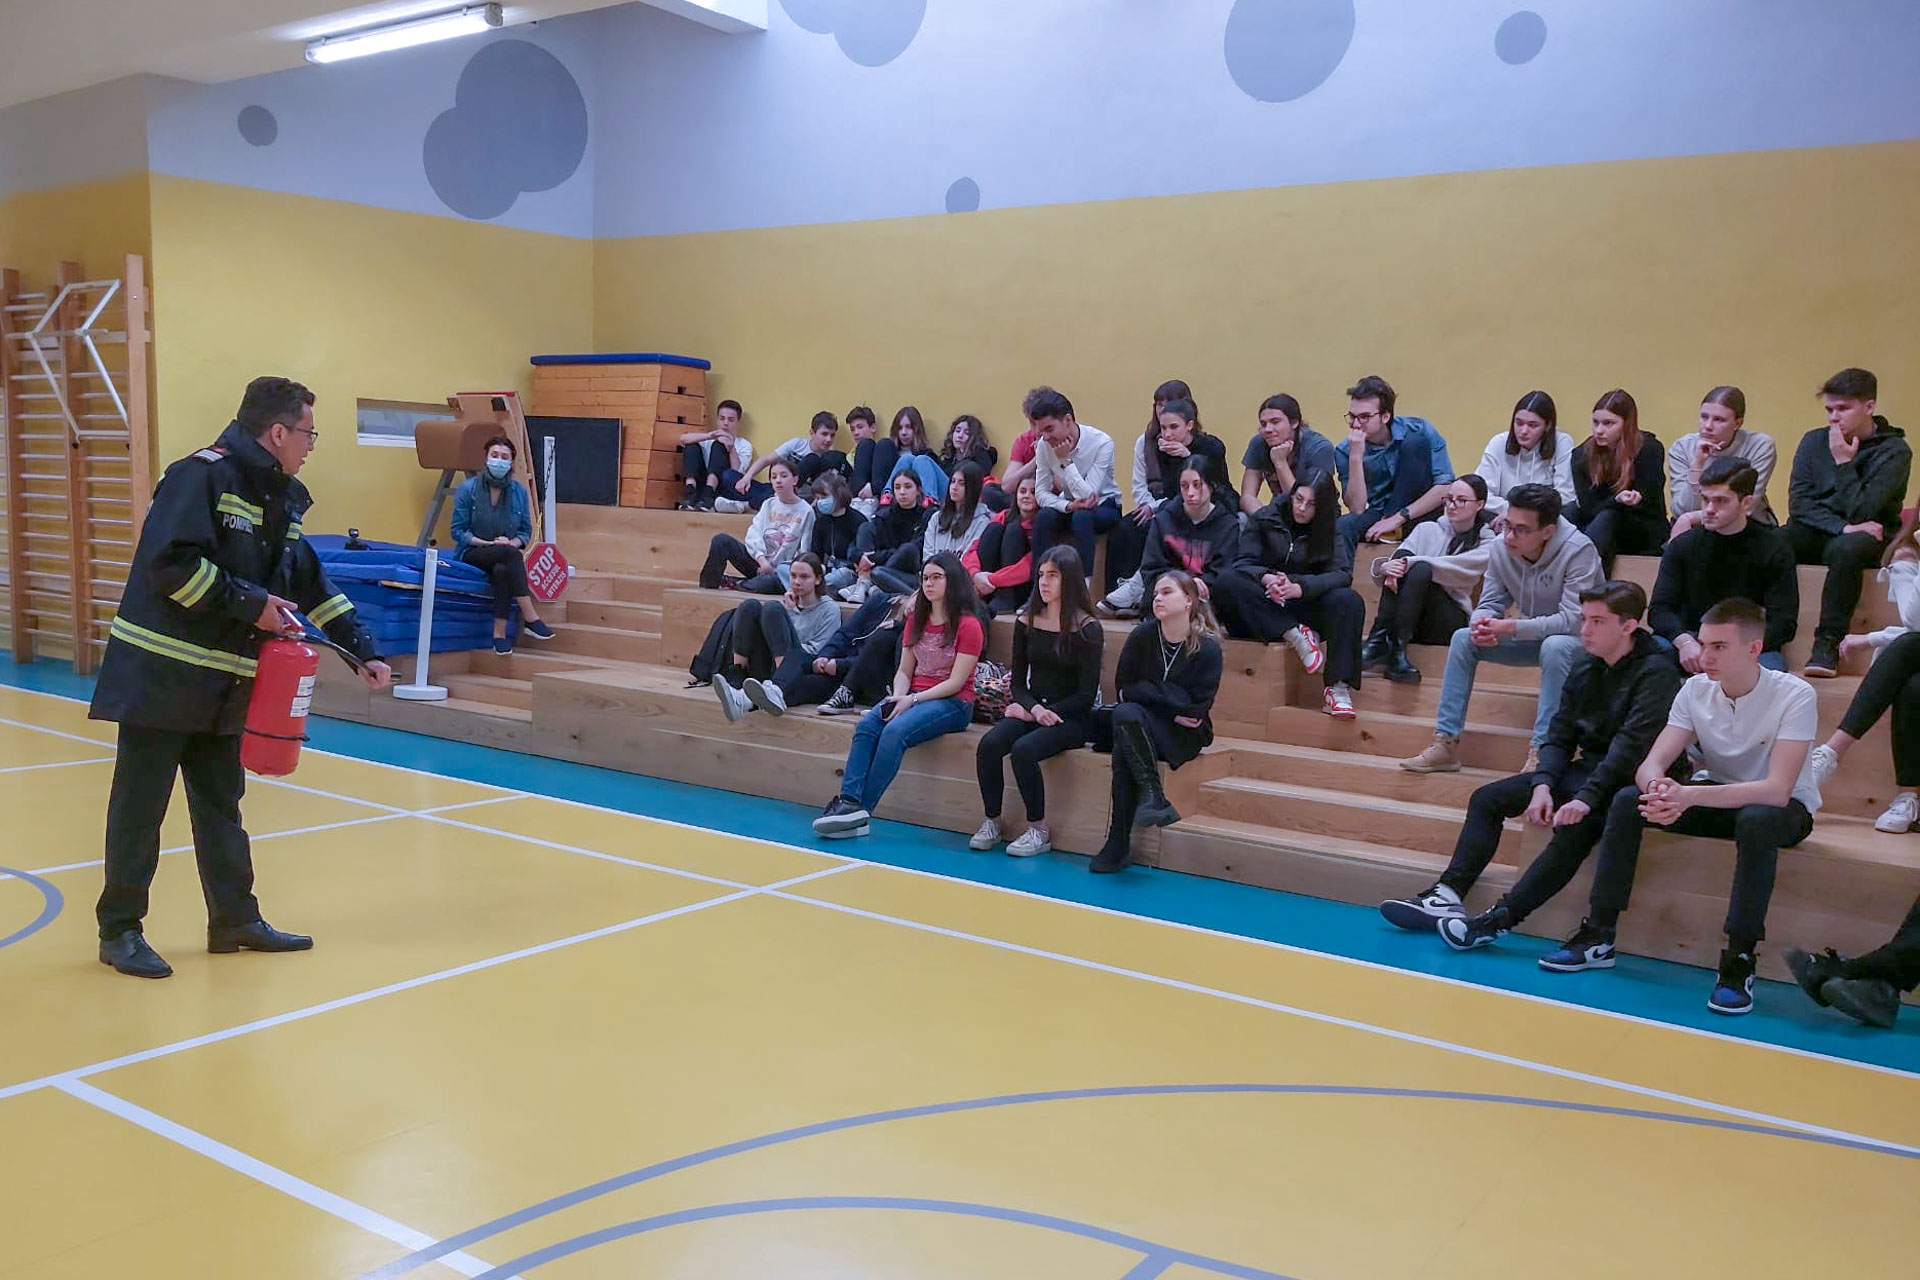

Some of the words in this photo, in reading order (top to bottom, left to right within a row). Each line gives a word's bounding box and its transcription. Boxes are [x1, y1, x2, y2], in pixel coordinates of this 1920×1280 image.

[529, 546, 555, 586] STOP
[541, 564, 561, 590] ACCESUL
[546, 570, 566, 598] INTERZIS
